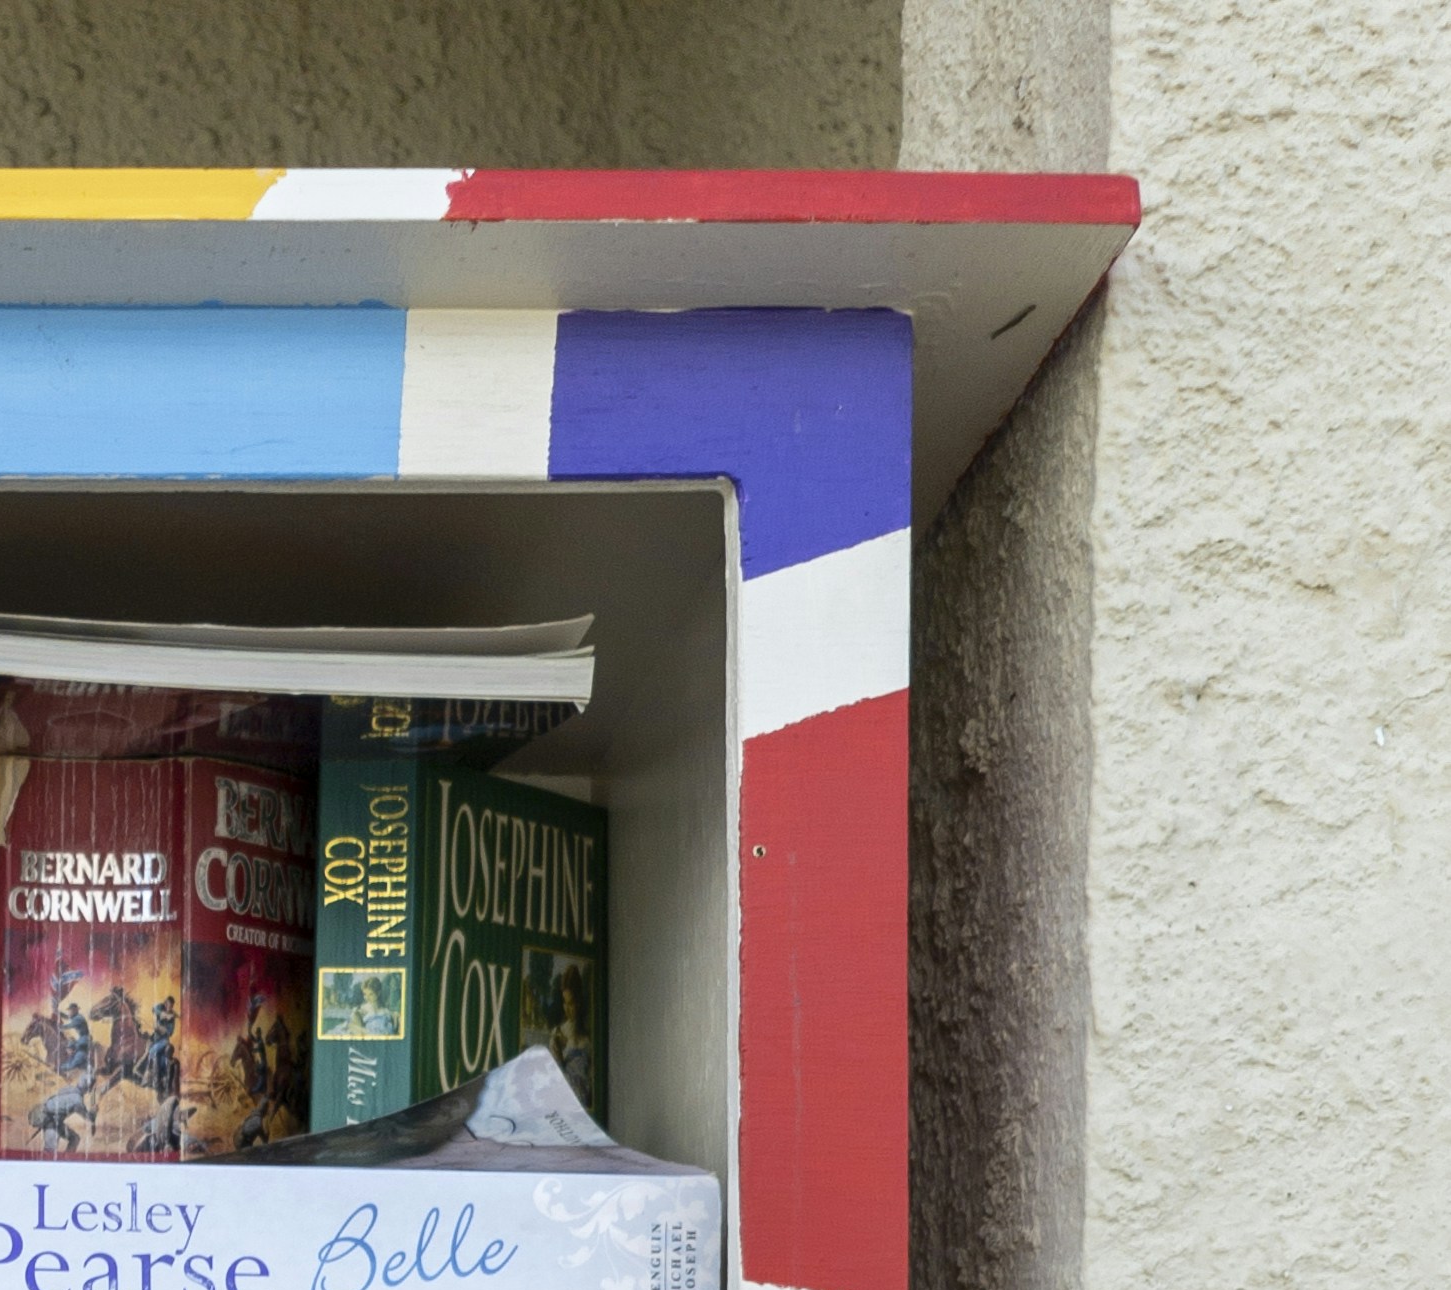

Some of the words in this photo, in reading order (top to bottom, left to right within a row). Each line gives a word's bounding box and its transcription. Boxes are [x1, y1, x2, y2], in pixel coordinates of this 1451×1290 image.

[20, 851, 167, 885] BERNARD
[324, 836, 366, 907] COX
[359, 784, 408, 958] JOSEPHINE
[431, 779, 594, 967] JOSEPHINE
[8, 888, 177, 923] CORNWELL
[437, 929, 512, 1095] COX
[33, 1182, 205, 1255] Lesley
